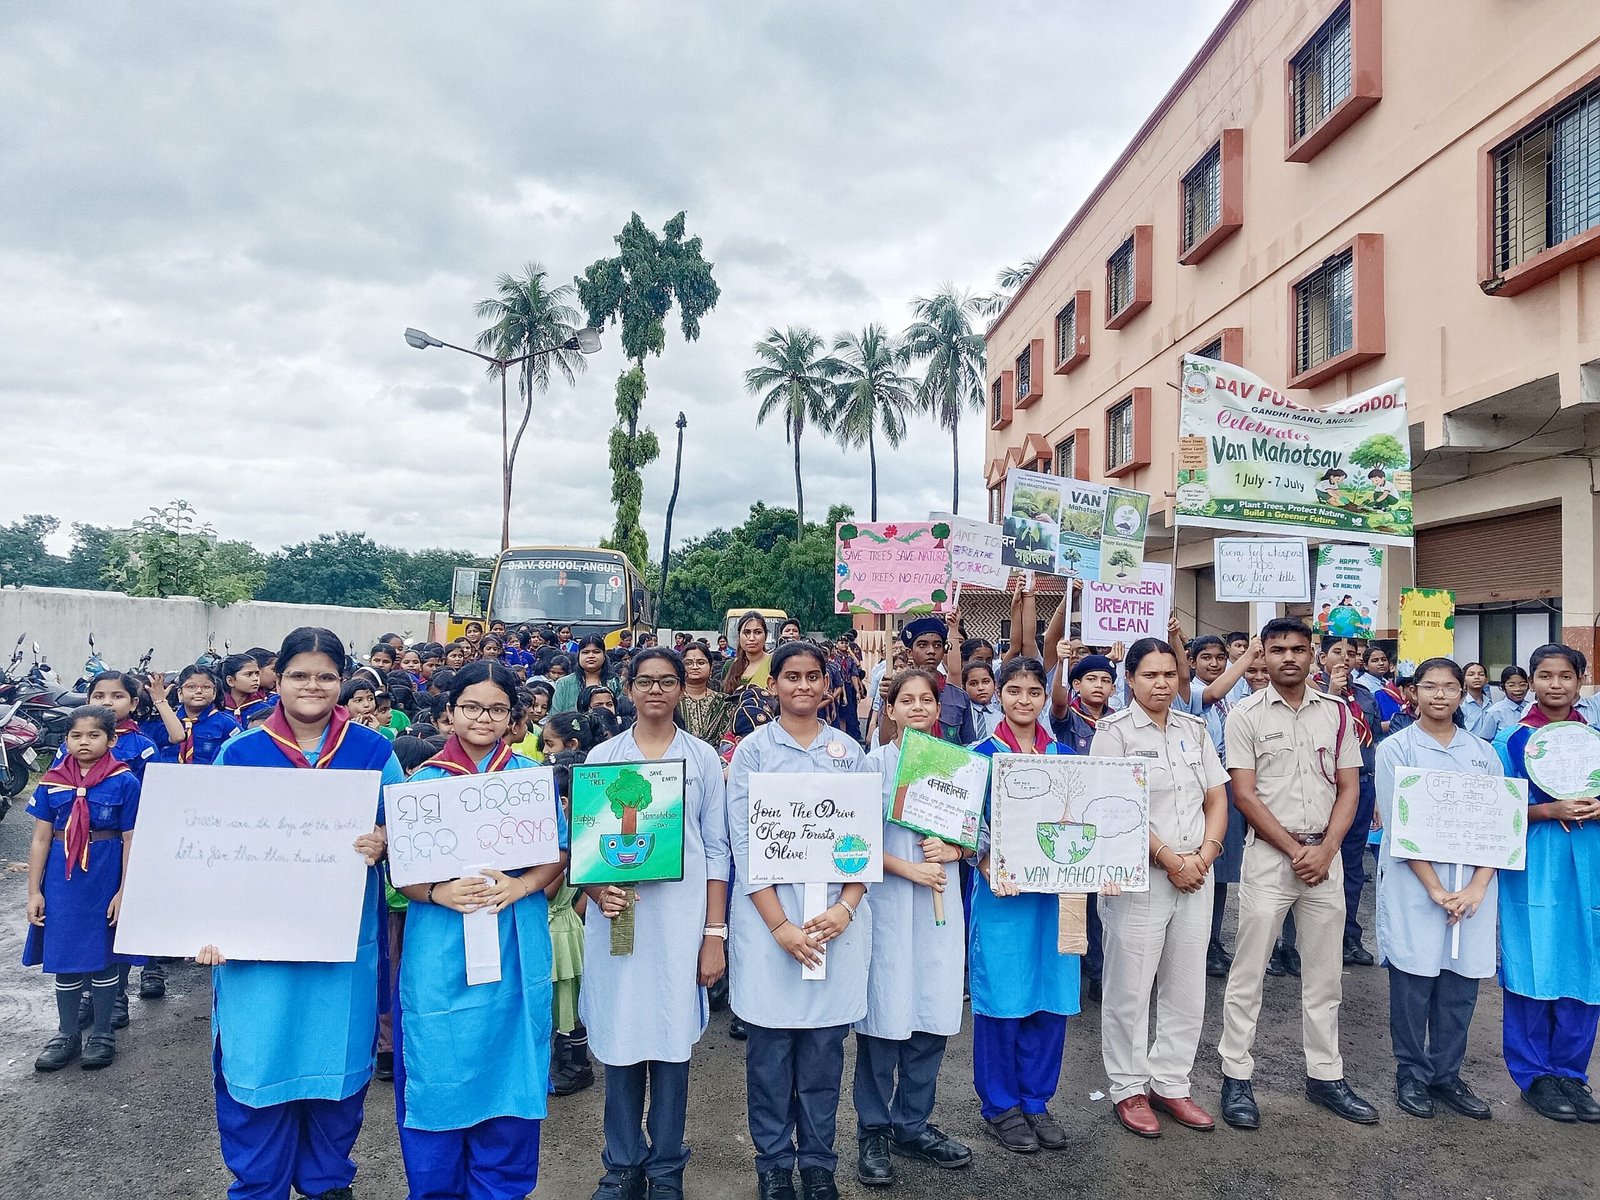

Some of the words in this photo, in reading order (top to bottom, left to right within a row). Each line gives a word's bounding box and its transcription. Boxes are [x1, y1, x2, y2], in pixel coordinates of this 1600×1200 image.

[1215, 376, 1255, 399] DAV
[1258, 387, 1328, 413] PUB
[1336, 393, 1407, 415] HOOL,
[1251, 406, 1290, 418] GANDHI
[1292, 413, 1323, 425] MARG,
[1325, 417, 1355, 425] ANGUL
[1216, 409, 1311, 441] Celebrates
[1211, 435, 1248, 465] Van
[1251, 437, 1343, 468] Mahotsav
[1234, 472, 1240, 483] 1
[1243, 473, 1264, 488] July
[1275, 476, 1281, 487] 7
[1283, 478, 1305, 492] July
[1071, 491, 1101, 507] VAN
[1240, 501, 1261, 509] Plant
[1263, 502, 1286, 511] Trees,
[1288, 504, 1317, 514] Protect
[1318, 508, 1347, 520] Nature,
[1243, 508, 1265, 517] Build
[1274, 511, 1308, 521] Greener
[1309, 515, 1338, 525] Future.
[953, 529, 980, 543] ANT
[1002, 535, 1016, 549] वन
[844, 550, 863, 561] SAVE
[869, 550, 892, 561] TREES
[896, 550, 914, 561] SAVE
[918, 550, 947, 561] NATURE
[953, 545, 994, 559] BREATHE
[1014, 545, 1051, 566] महोत्सव
[538, 561, 581, 571] SCHOOL,
[583, 563, 617, 573] ANGUL
[953, 561, 1000, 577] MORROW
[853, 572, 866, 582] NO
[871, 572, 895, 583] TREES
[899, 573, 911, 583] NO
[913, 573, 945, 585] FUTURE
[1095, 597, 1154, 616] BREATHE
[1099, 617, 1149, 634] CLEAN
[832, 758, 853, 769] DAV
[1471, 759, 1488, 769] DAV
[685, 778, 694, 786] AV
[750, 799, 781, 824] Join
[789, 802, 812, 818] The
[814, 799, 856, 818] Drive
[756, 821, 796, 843] Keep
[800, 824, 835, 840] Forests
[765, 841, 808, 860] Alive!
[1024, 866, 1050, 883] VAN
[1057, 864, 1135, 883] MAHOTSAV
